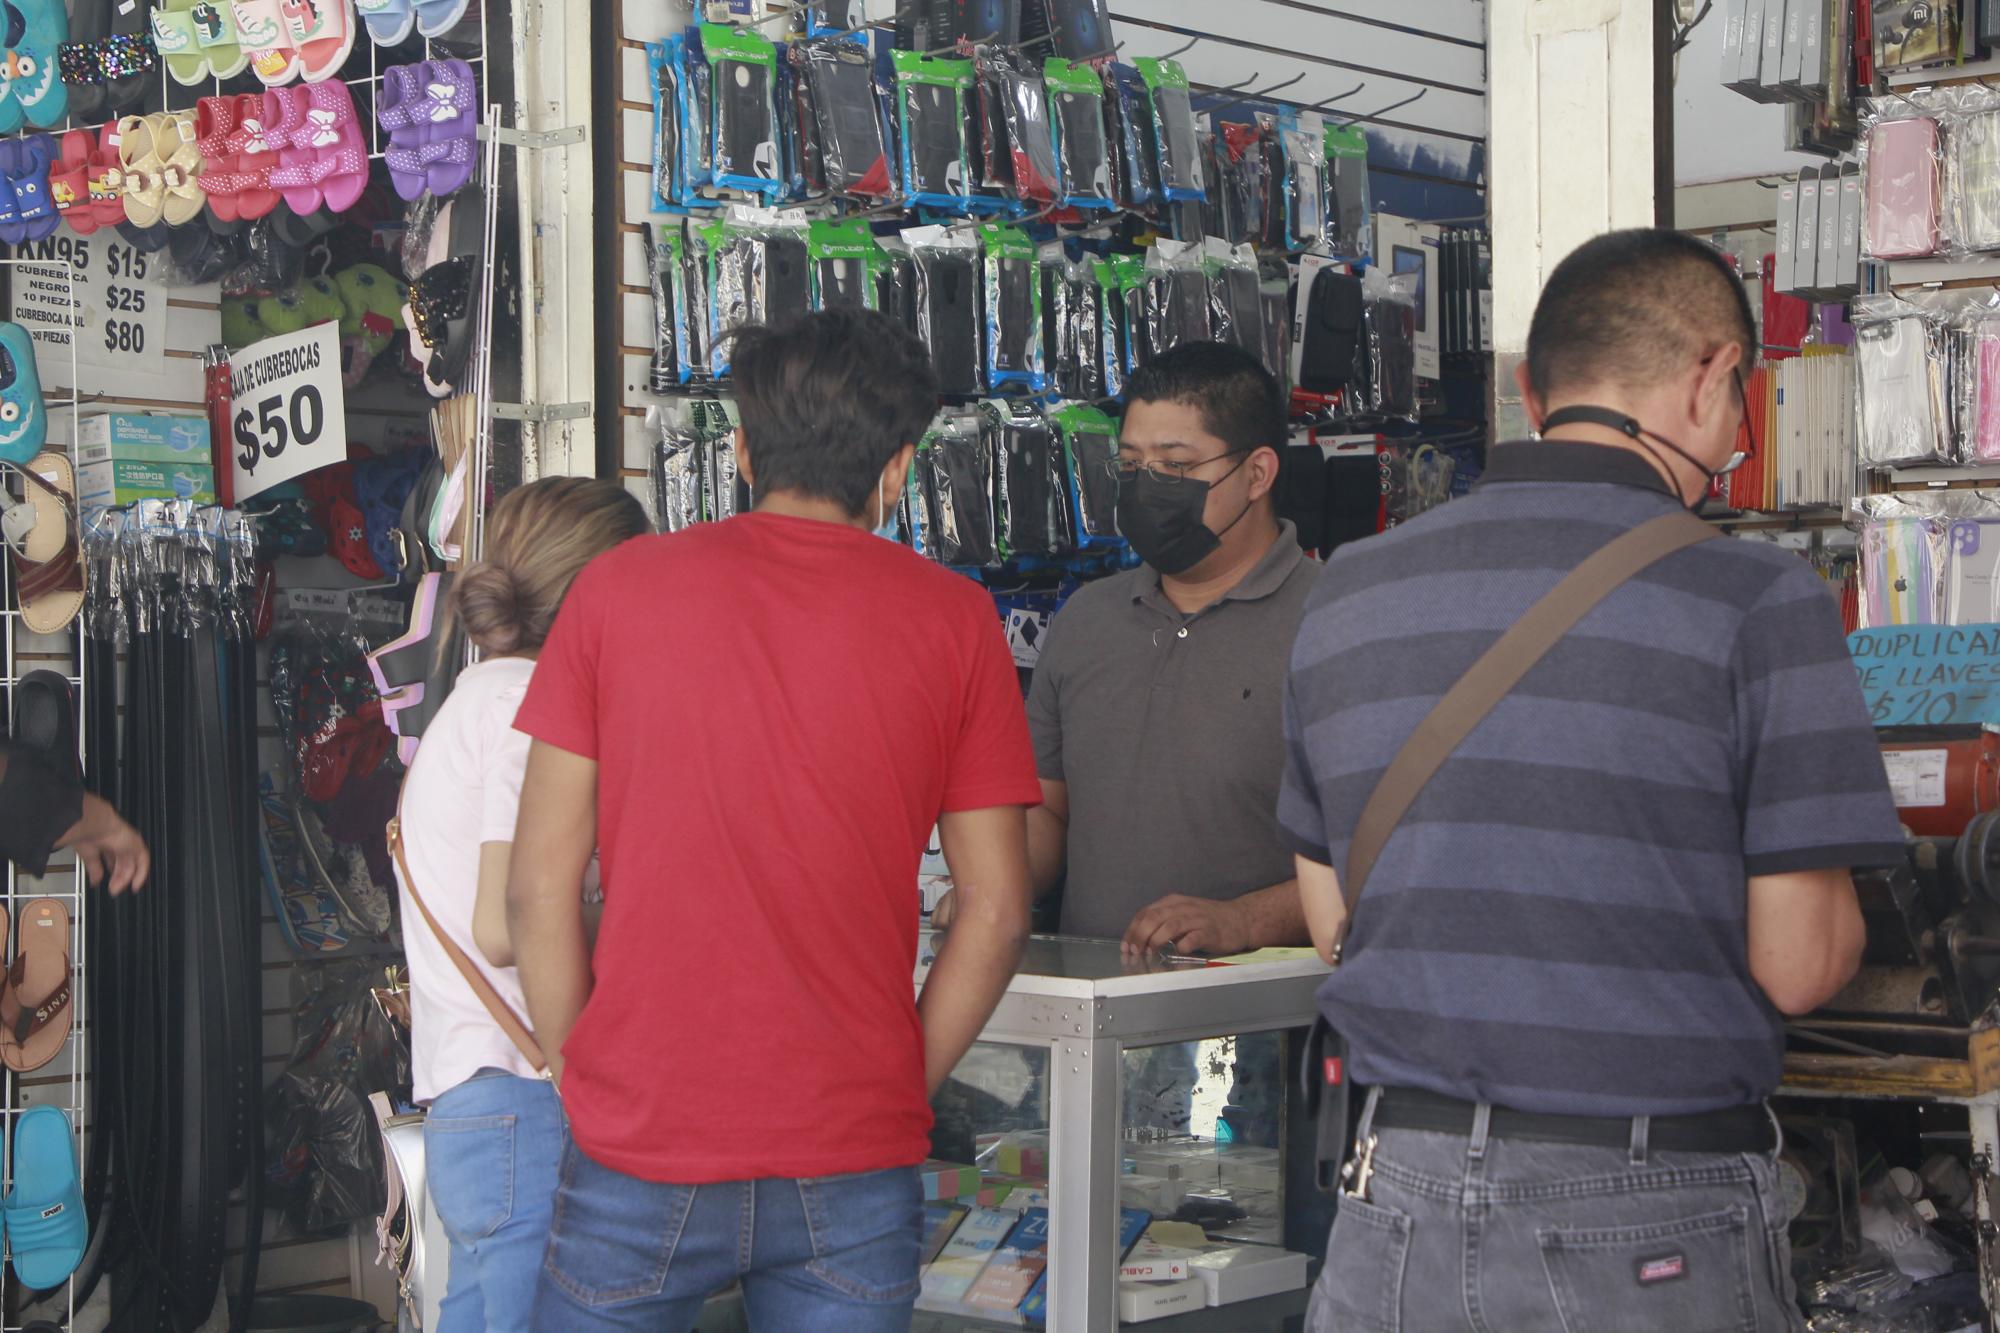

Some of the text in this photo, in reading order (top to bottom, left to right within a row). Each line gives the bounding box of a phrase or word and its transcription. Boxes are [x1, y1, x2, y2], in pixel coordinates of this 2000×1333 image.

[16, 235, 147, 280] KN95 $15
[16, 264, 88, 283] CUBREBOCA
[23, 292, 37, 302] 10
[29, 280, 146, 313] NEGRO $25
[15, 306, 145, 353] CUBREBOCA AUL $80
[32, 330, 70, 345] 50 PIEZAS
[243, 363, 256, 393] DE
[254, 341, 321, 387] CUBREBOCAS
[233, 383, 324, 476] $50
[1896, 662, 2000, 686] LLAVES
